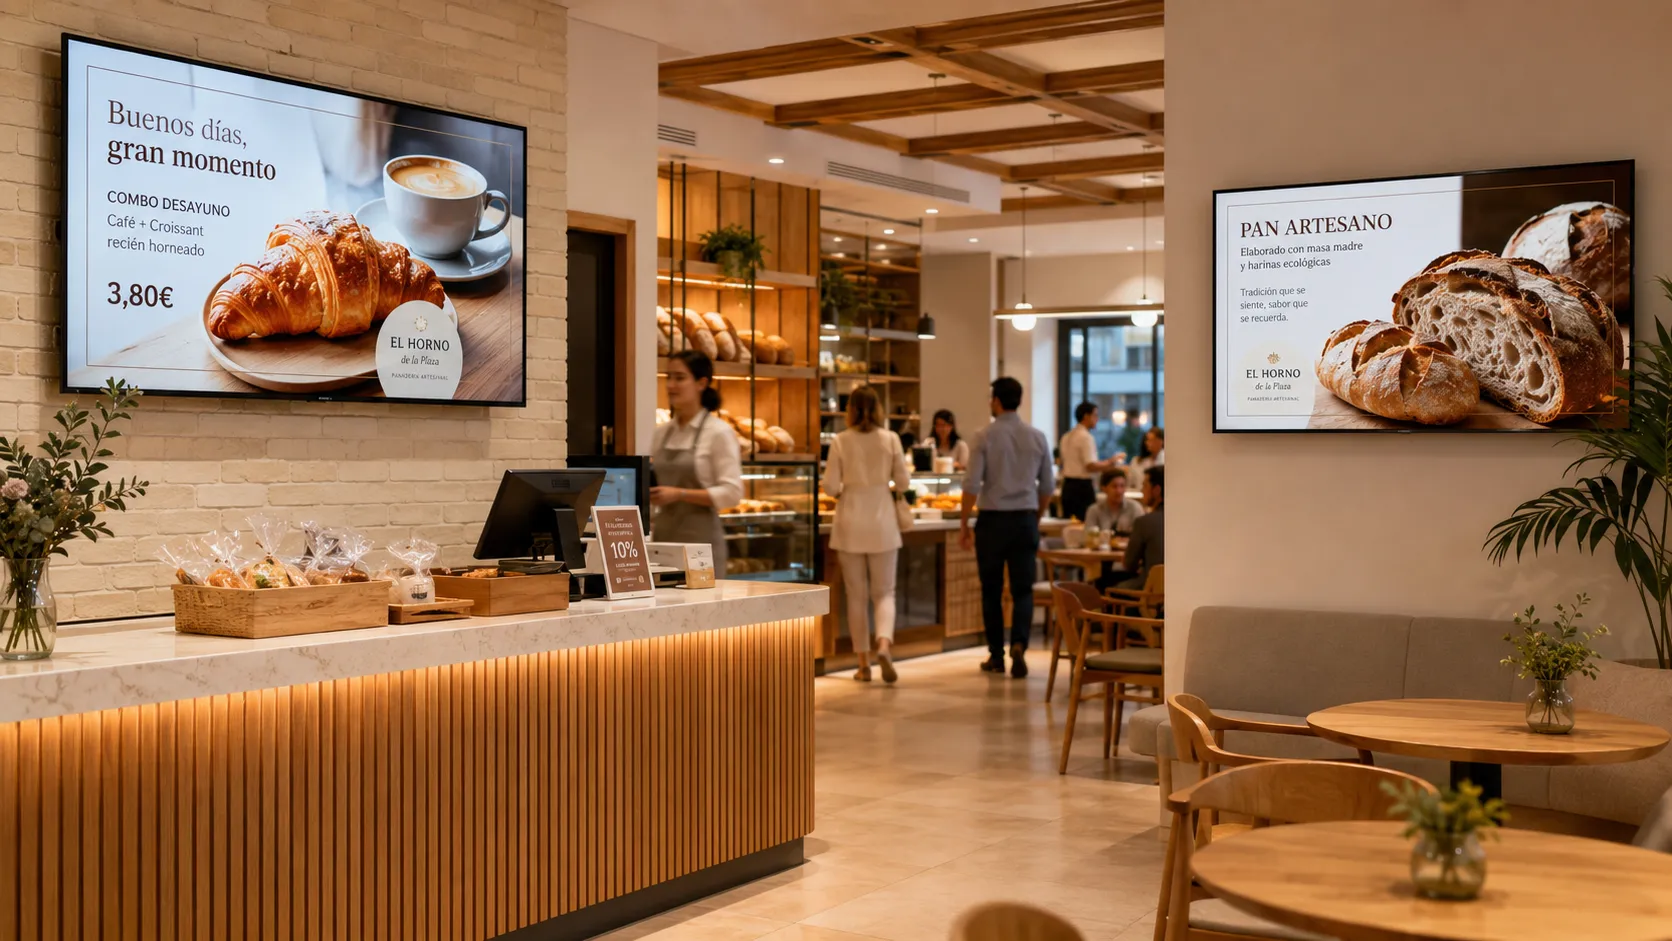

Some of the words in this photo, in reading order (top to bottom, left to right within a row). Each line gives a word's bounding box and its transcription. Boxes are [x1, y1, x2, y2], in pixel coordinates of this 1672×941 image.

[108, 100, 194, 136] Buenos
[202, 118, 246, 149] días,
[108, 139, 164, 165] gran
[173, 149, 276, 180] momento
[108, 191, 158, 208] COMBO
[163, 198, 230, 217] DESAYUNO
[108, 214, 135, 228] Café
[150, 219, 204, 236] Croissant
[1241, 221, 1279, 238] PAN
[1285, 214, 1392, 235] ARTESANO
[108, 237, 144, 251] recién
[150, 239, 204, 256] horneado
[1241, 246, 1285, 256] Elaborado
[1288, 246, 1304, 254] con
[1307, 245, 1330, 253] masa
[1334, 242, 1363, 251] madre
[1241, 263, 1245, 272] y
[1249, 260, 1280, 269] harinas
[1284, 258, 1331, 269] ecológicas
[108, 282, 173, 309] 3,80€
[1241, 287, 1277, 296] Tradición
[1279, 288, 1294, 296] que
[1241, 301, 1266, 309] siente,
[1269, 300, 1290, 308] sabor
[1293, 301, 1308, 309] que
[1252, 313, 1288, 322] recuerda.
[391, 337, 404, 348] EL
[408, 338, 450, 351] HORNO
[401, 355, 410, 364] de
[412, 355, 418, 364] la
[421, 356, 439, 365] Plaza
[1247, 370, 1258, 378] EL
[1262, 369, 1300, 378] HORNO
[1255, 382, 1263, 390] de
[1273, 382, 1291, 390] Plaza
[610, 541, 638, 559] 10%
